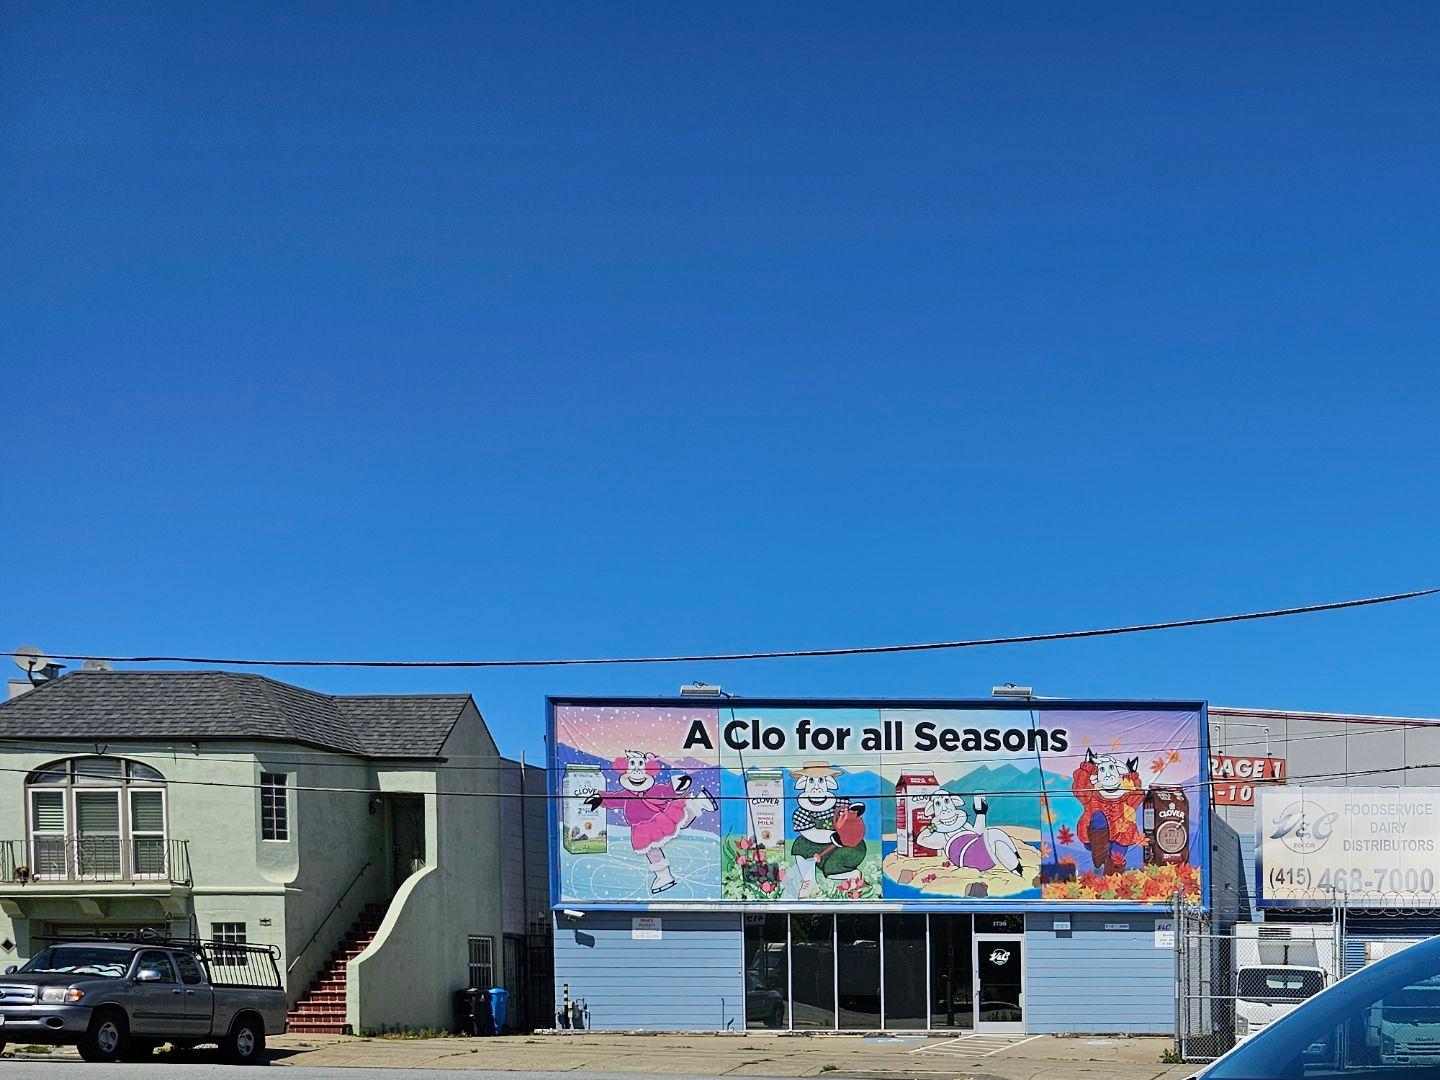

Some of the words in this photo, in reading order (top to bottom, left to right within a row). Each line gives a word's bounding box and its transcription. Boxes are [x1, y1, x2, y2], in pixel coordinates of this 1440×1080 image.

[683, 720, 713, 750] A
[724, 719, 786, 750] Clo
[796, 719, 851, 750] for
[861, 720, 903, 751] all
[914, 721, 1069, 752] Seasons
[1159, 809, 1185, 819] CLOVER
[1344, 803, 1433, 816] FOODSERVICE
[1370, 821, 1408, 834] DAIRY
[1343, 839, 1435, 852] DISTRIBUTORS
[1269, 867, 1312, 890] (415)
[1318, 867, 1435, 894] 468-7000
